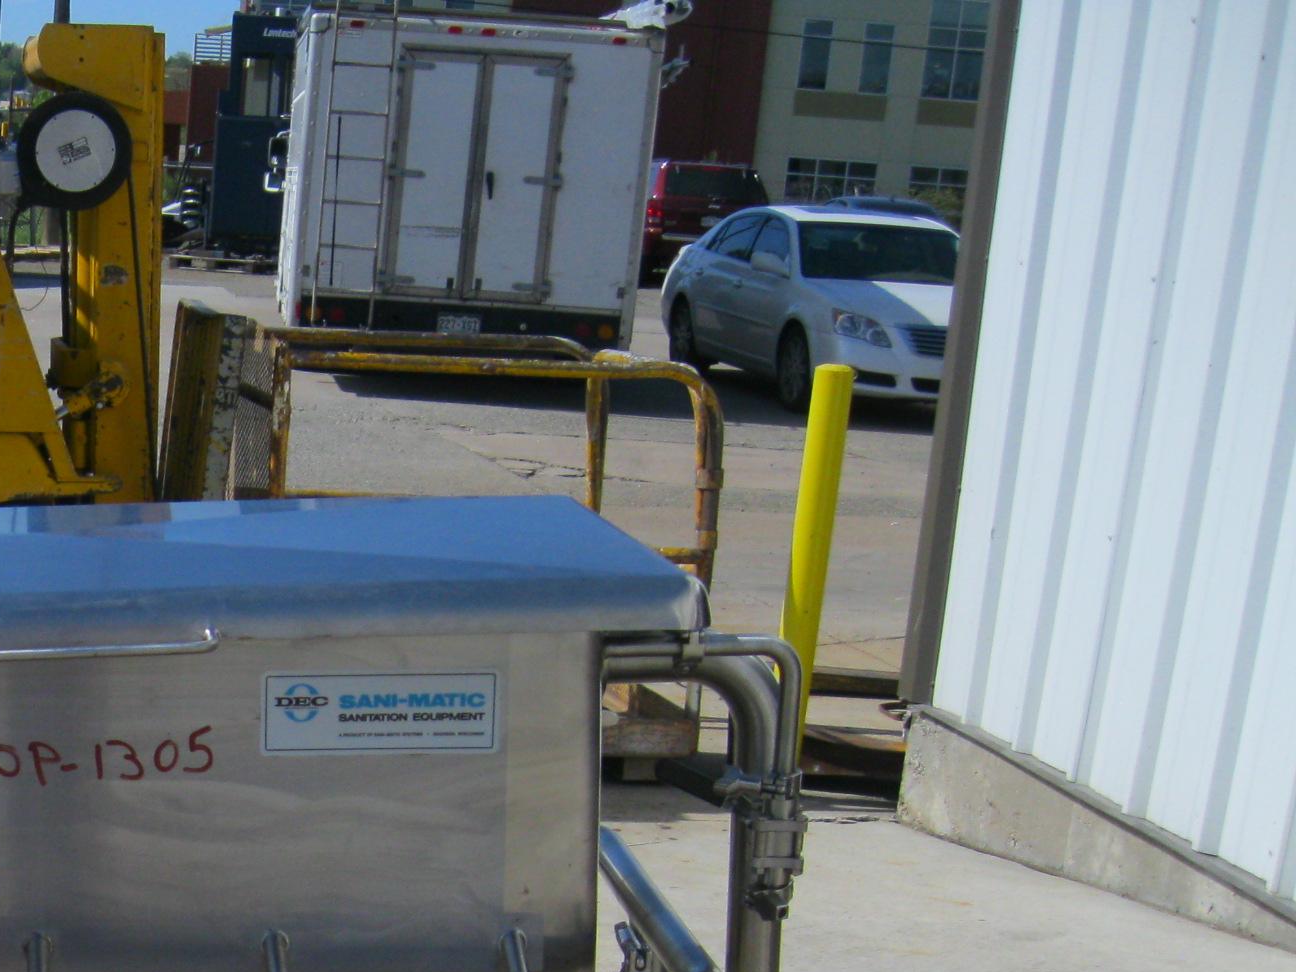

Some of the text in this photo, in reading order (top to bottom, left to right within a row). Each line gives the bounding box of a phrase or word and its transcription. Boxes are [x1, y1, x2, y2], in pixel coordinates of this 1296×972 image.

[274, 692, 486, 710] DEC SANI-MATIC
[338, 711, 486, 723] SANITATION EQUIPMENT
